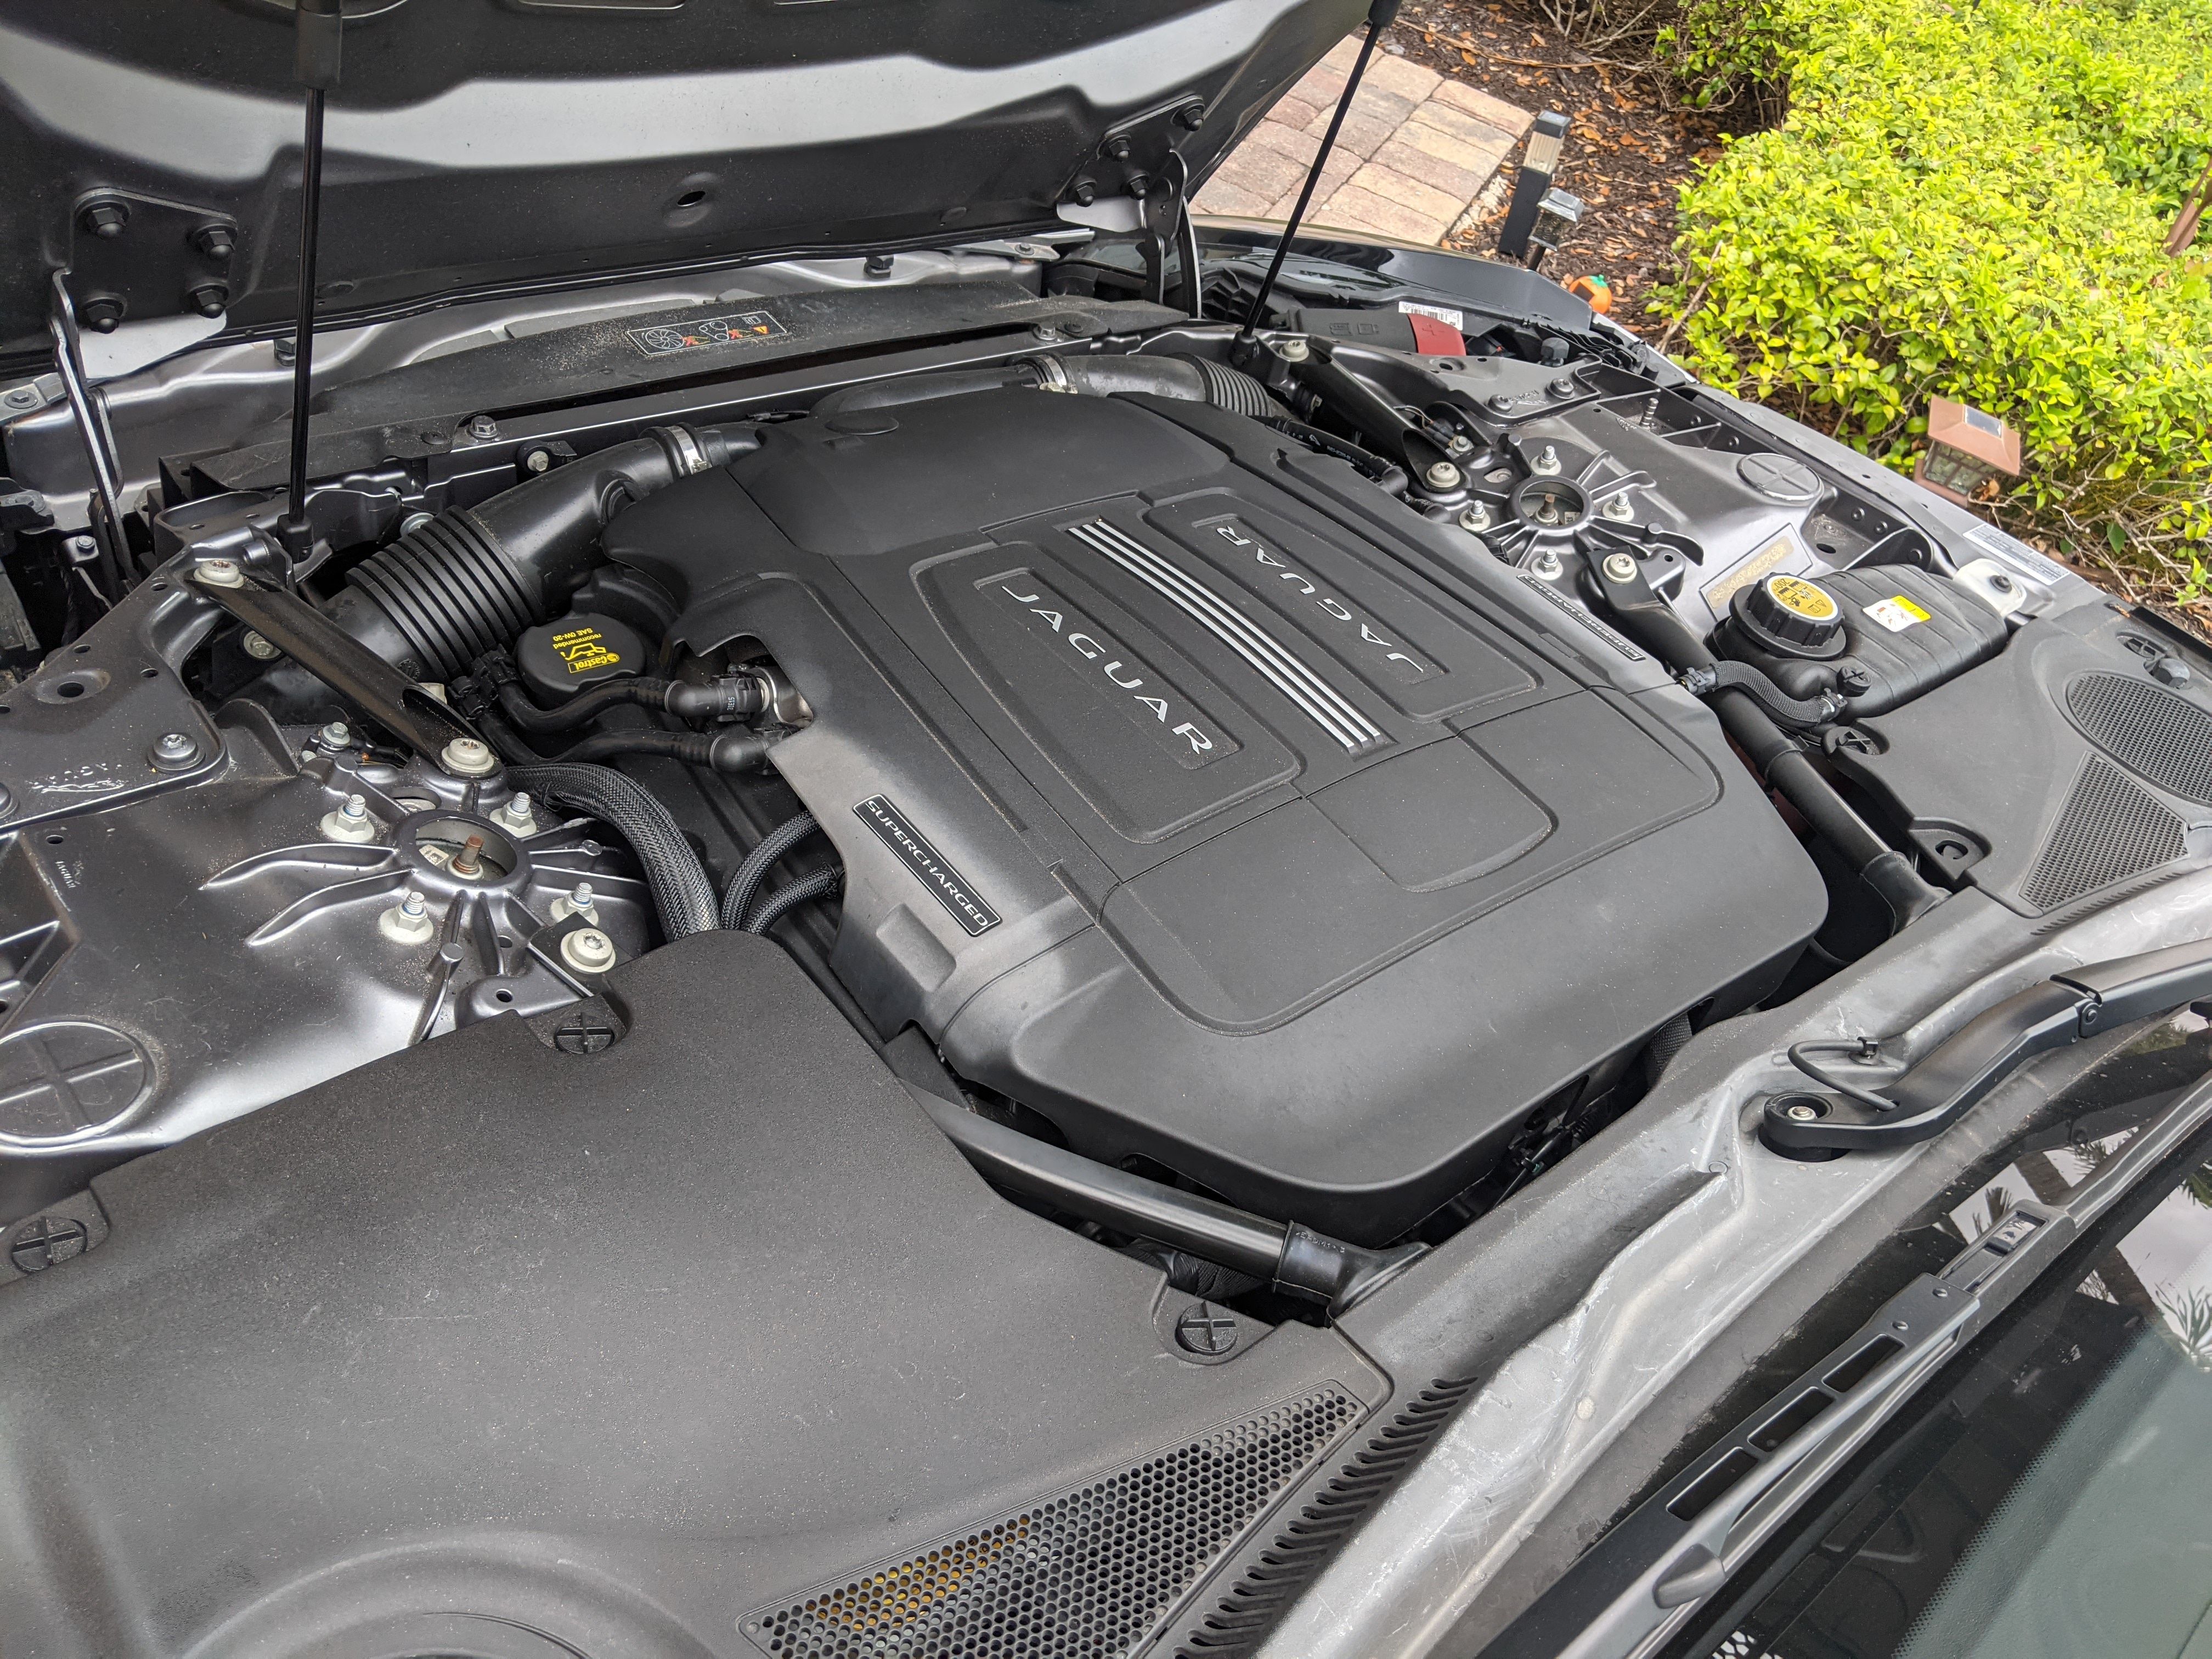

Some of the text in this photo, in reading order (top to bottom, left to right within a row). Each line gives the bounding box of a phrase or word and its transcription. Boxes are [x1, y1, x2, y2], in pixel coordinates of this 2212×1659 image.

[1216, 526, 1424, 673] JAGUAR
[1525, 575, 1639, 657] SUPERCHARGED
[552, 628, 593, 641] SAE 0W-20
[552, 633, 602, 649] recommended
[573, 656, 608, 670] Castrol
[1001, 585, 1213, 755] JAGUAR
[55, 861, 76, 888] JAGUAR
[865, 800, 988, 926] SUPERCHARGED
